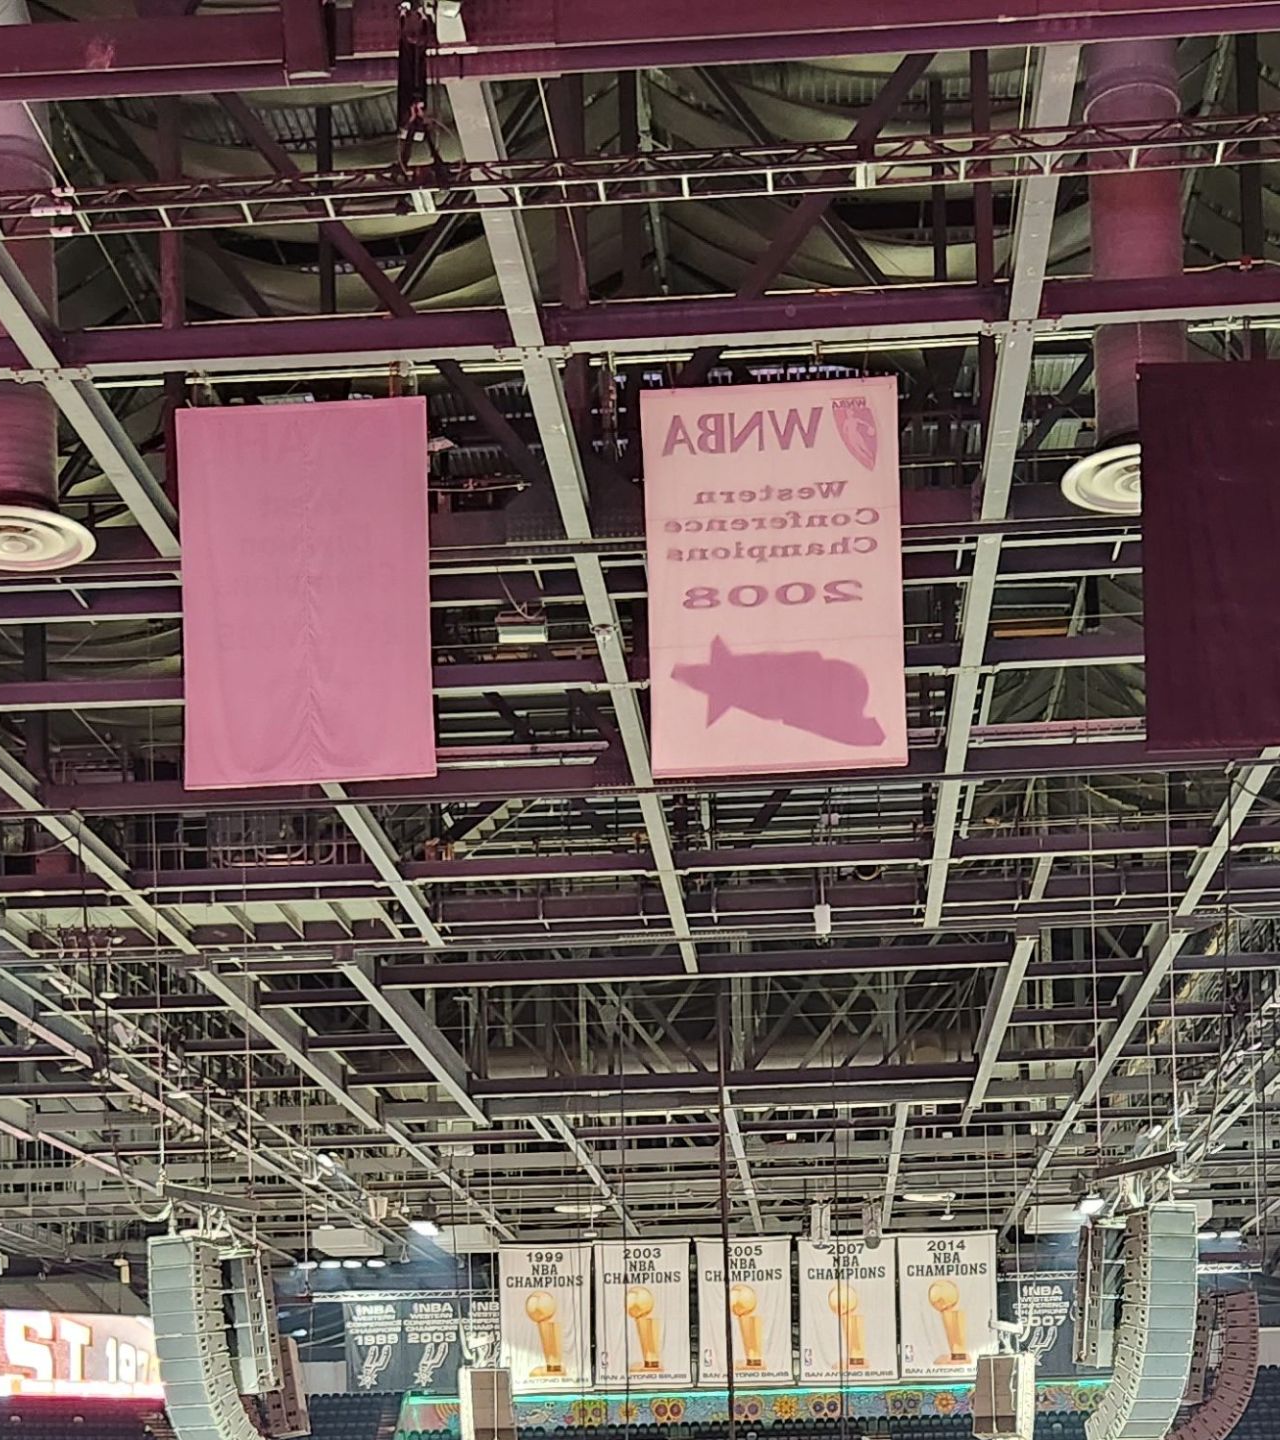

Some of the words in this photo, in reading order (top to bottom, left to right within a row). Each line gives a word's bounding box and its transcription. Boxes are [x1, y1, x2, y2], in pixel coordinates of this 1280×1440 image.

[726, 1246, 763, 1258] 2005
[827, 1243, 864, 1255] 2007
[927, 1240, 966, 1252] 2014
[526, 1251, 564, 1263] 1999
[623, 1247, 662, 1260] 2003
[933, 1252, 961, 1265] NBA
[628, 1261, 656, 1272] NBA
[729, 1258, 757, 1270] NBA
[832, 1255, 860, 1268] NBA
[531, 1264, 558, 1276] NBA
[704, 1269, 783, 1283] CHAMPIONS
[807, 1267, 886, 1280] CHAMPIONS
[906, 1263, 987, 1277] CHAMPIONS
[505, 1275, 584, 1288] CHAMPIONS
[603, 1271, 682, 1285] CHAMPIONS
[1029, 1285, 1063, 1296] NBA
[364, 1304, 396, 1315] NBA
[419, 1302, 453, 1313] NBA
[1019, 1315, 1067, 1327] 2007
[407, 1331, 457, 1344] 2003
